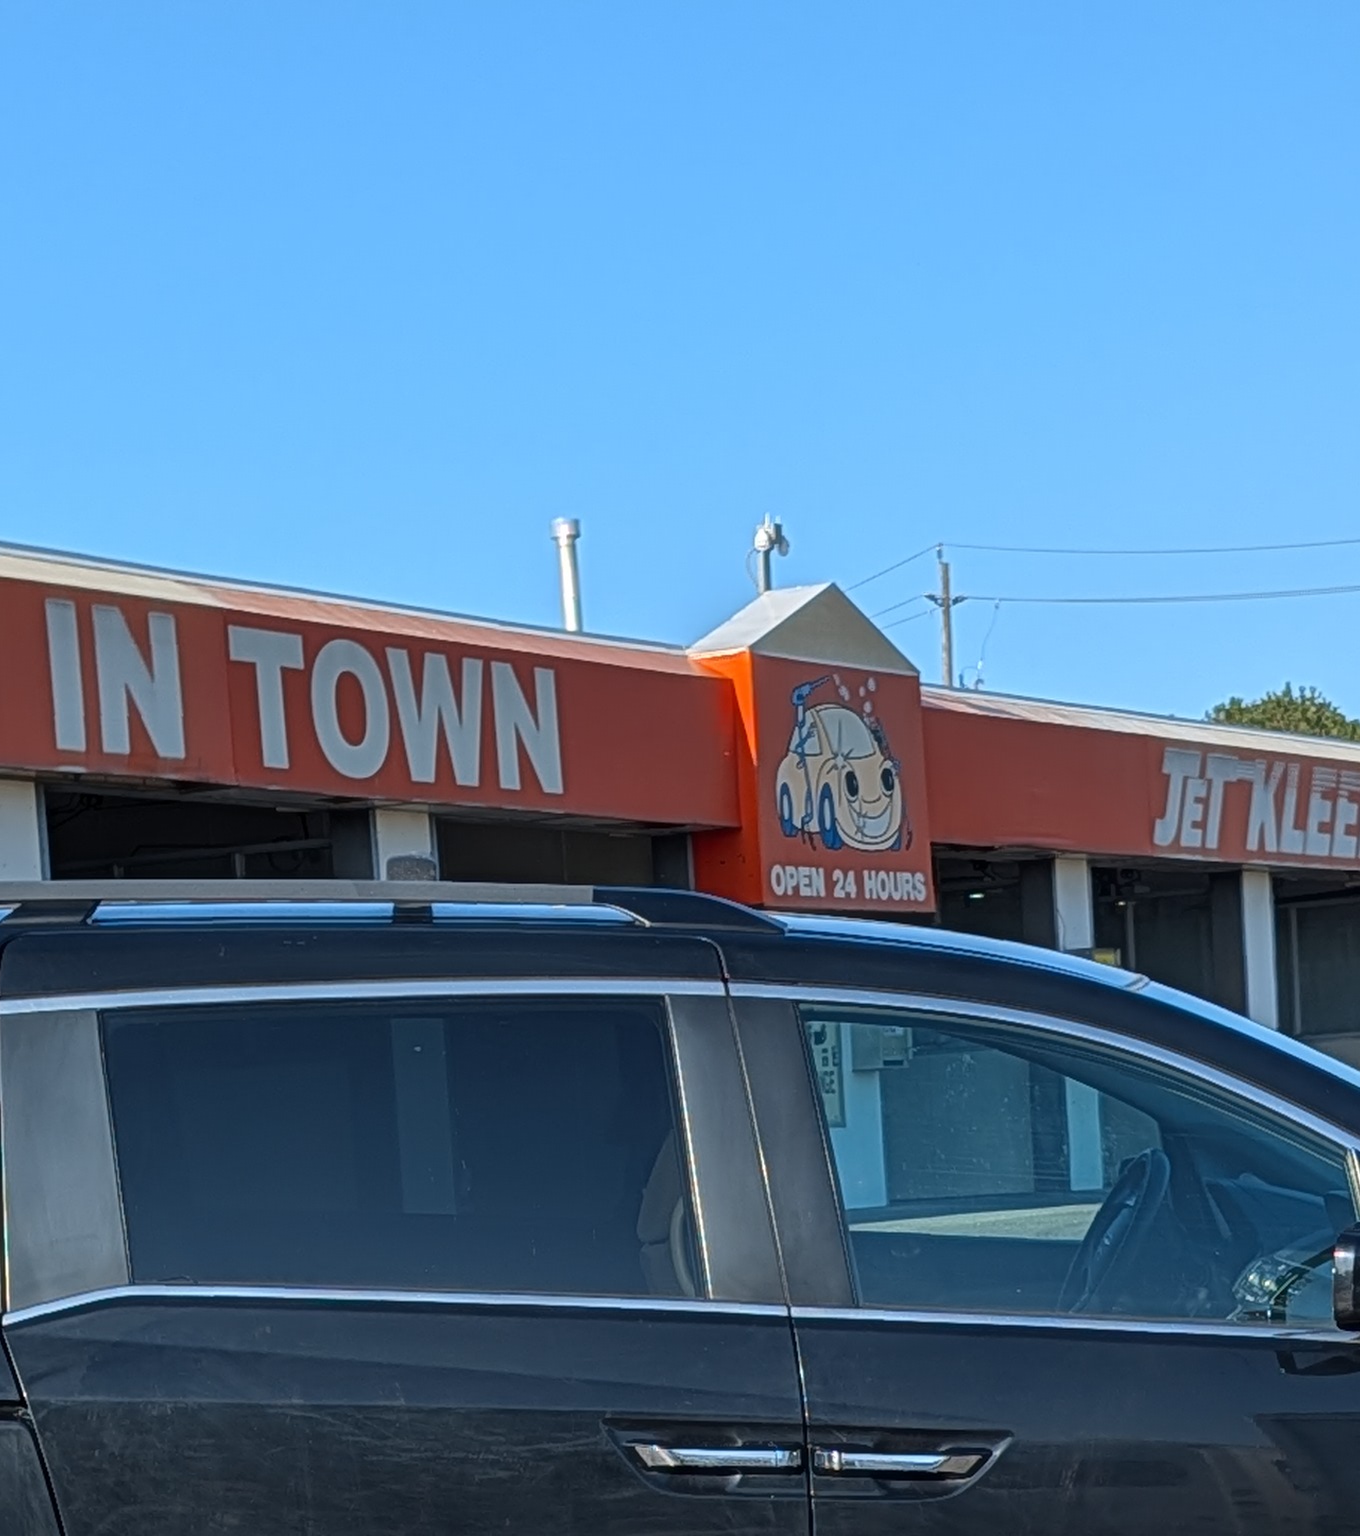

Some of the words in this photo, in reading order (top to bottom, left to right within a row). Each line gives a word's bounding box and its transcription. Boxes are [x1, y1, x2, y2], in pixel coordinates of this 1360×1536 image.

[45, 598, 185, 759] IN
[228, 625, 563, 794] TOWN
[1153, 747, 1238, 850] JET
[771, 864, 826, 898] OPEN
[833, 869, 857, 899] 24
[864, 869, 927, 901] HOURS
